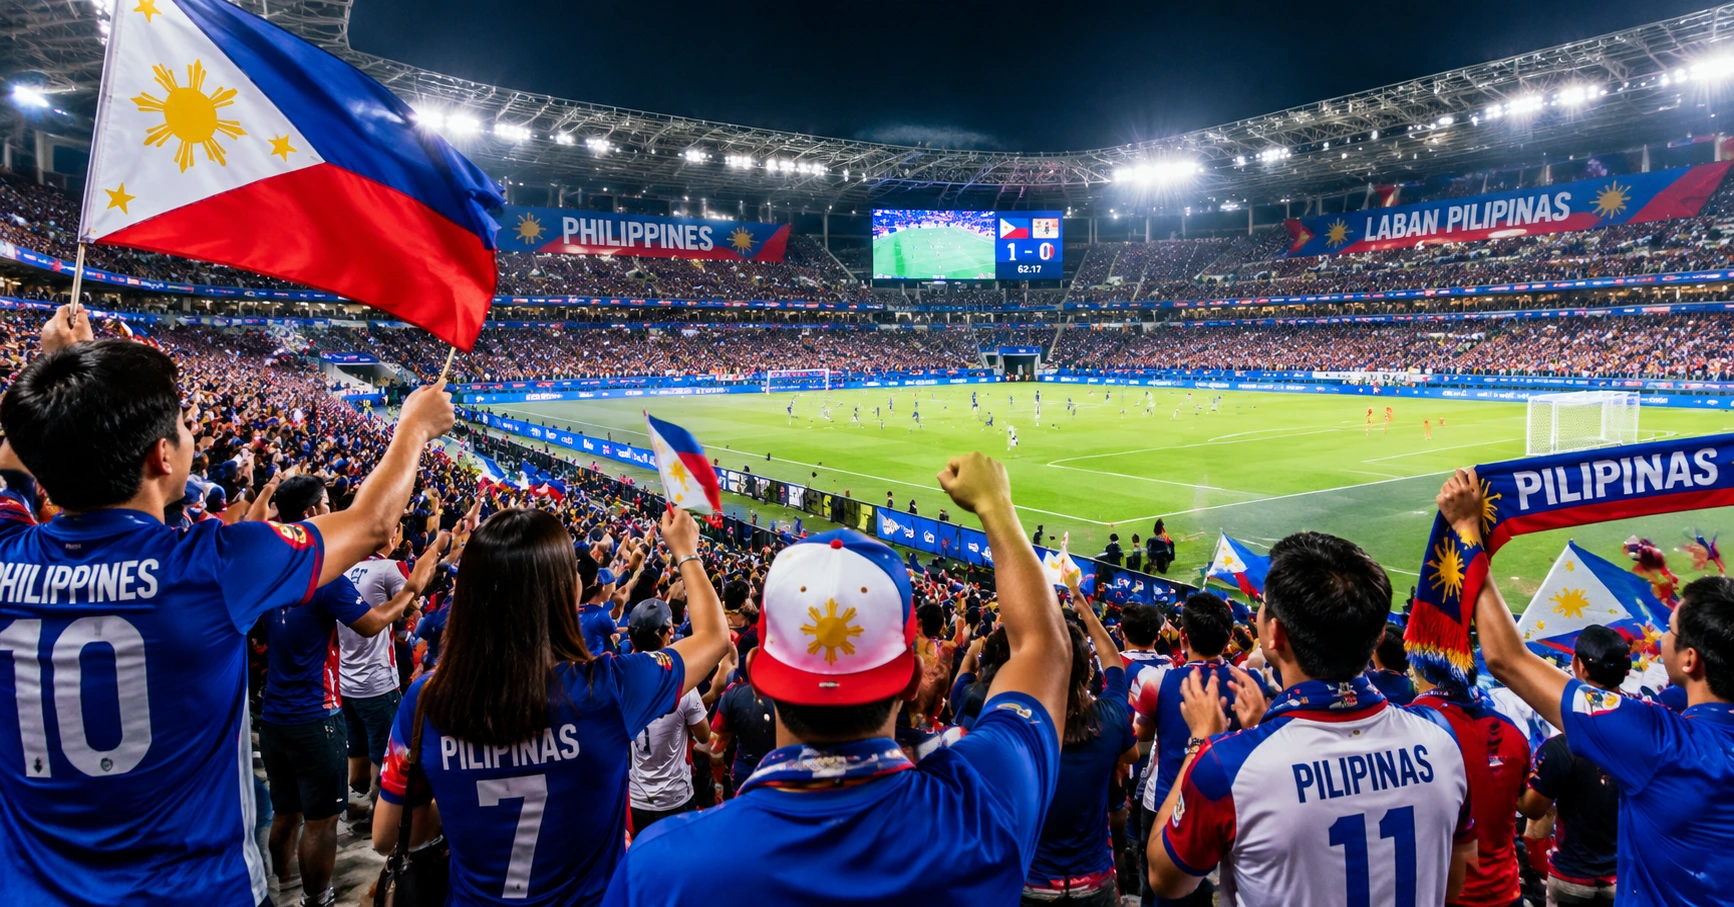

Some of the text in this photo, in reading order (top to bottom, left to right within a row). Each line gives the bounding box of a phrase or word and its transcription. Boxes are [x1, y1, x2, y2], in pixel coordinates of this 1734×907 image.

[562, 216, 713, 251] PHILIPPINES
[1364, 191, 1572, 242] LABAN PILIPINAS
[1007, 242, 1017, 261] 1
[1513, 447, 1719, 510] PILIPINAS
[0, 615, 152, 778] 10
[440, 723, 580, 771] PILIPINAS
[1291, 744, 1434, 803] PILIPINAS
[476, 773, 549, 899] 7
[1328, 805, 1417, 907] 11
